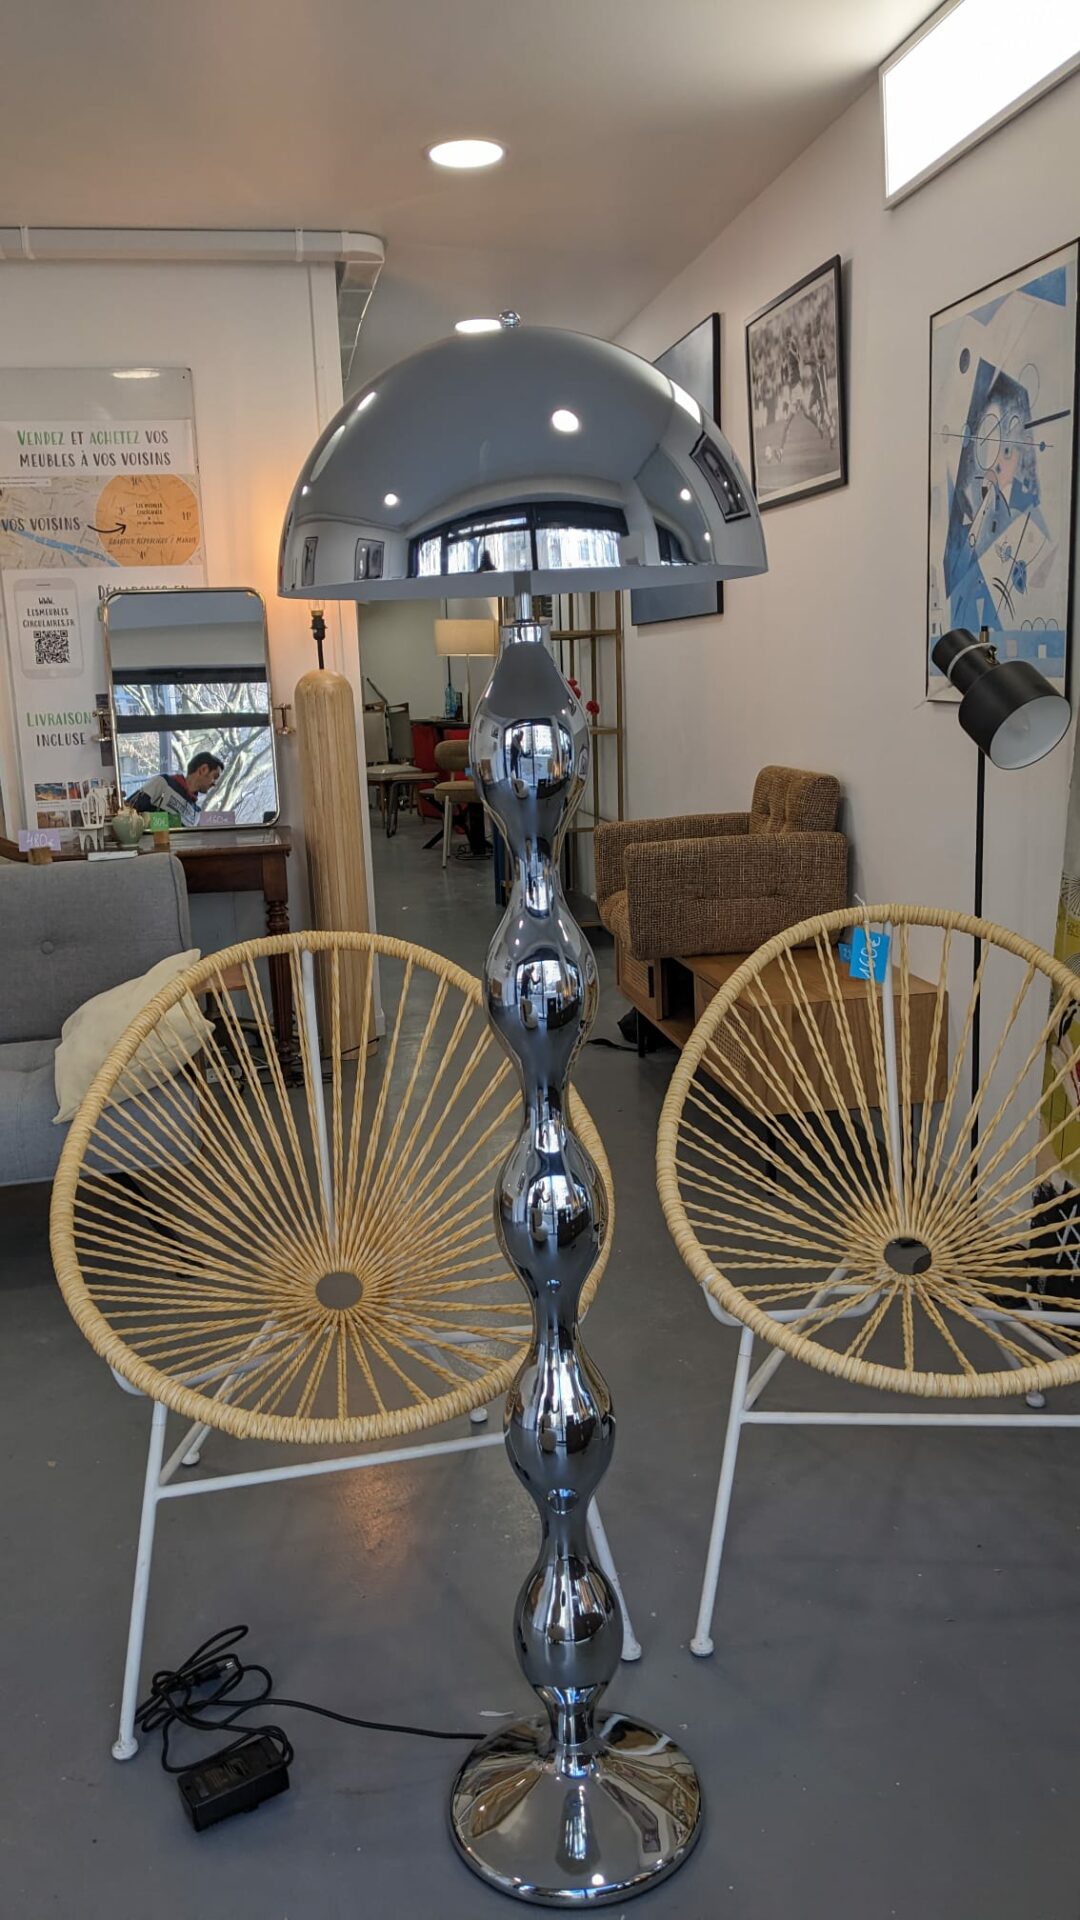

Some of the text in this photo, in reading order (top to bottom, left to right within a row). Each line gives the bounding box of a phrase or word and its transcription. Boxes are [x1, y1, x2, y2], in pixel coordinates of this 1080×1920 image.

[17, 430, 168, 446] VENDEZ ET ACHETEZ VOS
[20, 449, 171, 467] MEUBLES À VOS VOISINS
[1, 517, 81, 531] VOS VOISINS
[27, 608, 69, 616] LESMEUBLES
[26, 711, 92, 727] LIVRAISON
[36, 732, 87, 747] INCLUSE
